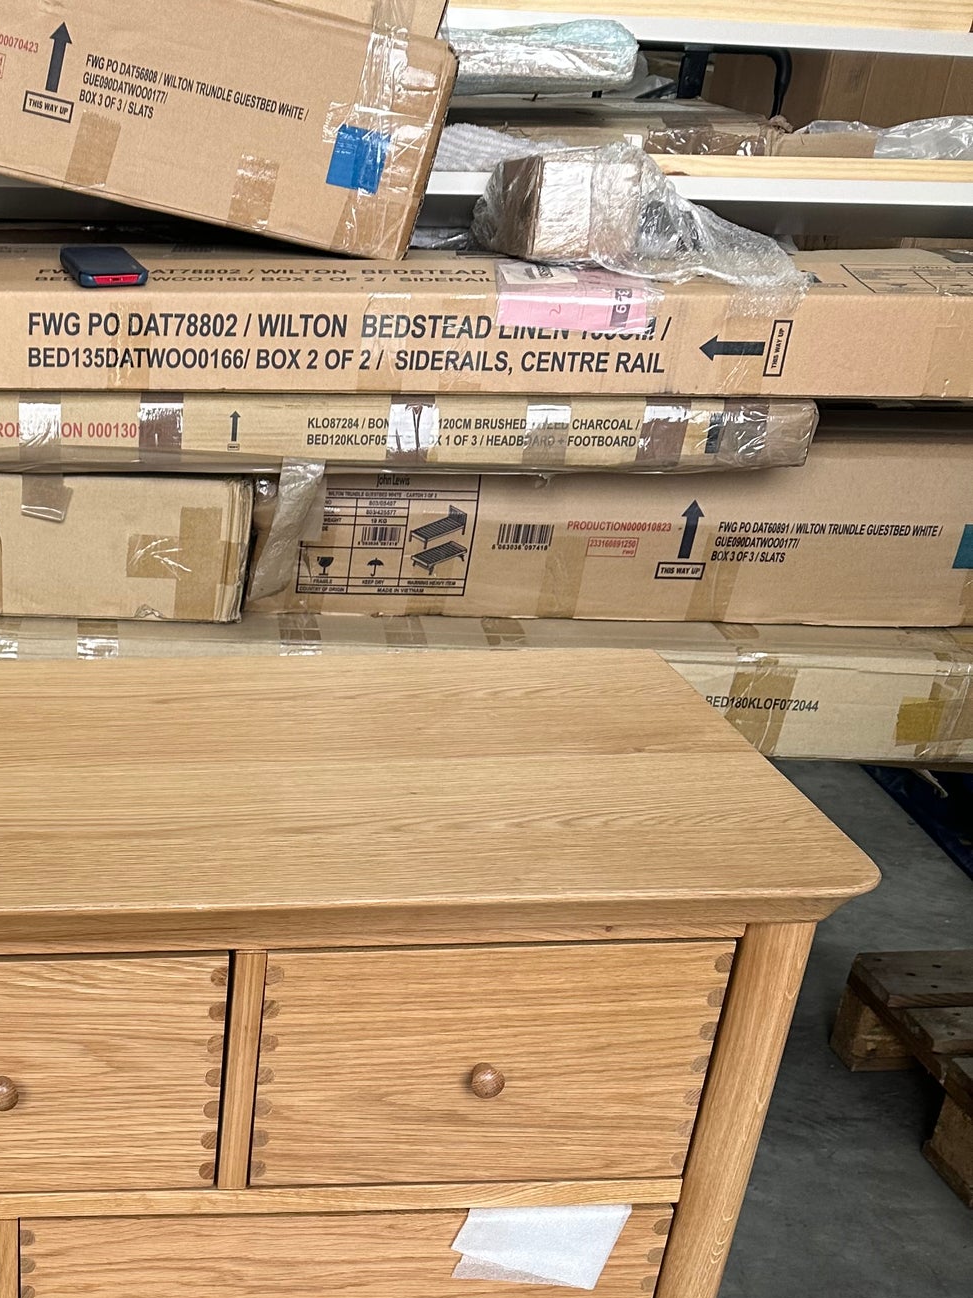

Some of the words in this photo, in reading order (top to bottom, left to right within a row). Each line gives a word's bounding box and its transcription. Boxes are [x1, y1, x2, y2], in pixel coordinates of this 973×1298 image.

[86, 54, 105, 70] FWG
[106, 58, 118, 73] PO
[119, 61, 158, 84] DAT56808
[163, 73, 194, 92] WILTON
[195, 81, 232, 102] TRUNDLE
[233, 91, 277, 113] GUESTBED
[277, 102, 304, 121] WHITE
[28, 98, 43, 109] THIS
[44, 102, 58, 113] WAY
[59, 105, 69, 115] UP
[79, 89, 97, 104] BOX
[97, 93, 104, 106] 3
[104, 95, 116, 108] OF
[116, 98, 123, 110] 3
[128, 101, 154, 119] SLATS
[361, 268, 487, 276] BEDSTEAD
[28, 312, 80, 337] FWG
[88, 312, 119, 337] PO
[128, 312, 237, 338] DAT78802
[243, 313, 252, 337] /
[258, 313, 347, 338] WILTON
[361, 314, 492, 339] BEDSTEAD
[660, 316, 672, 341] /
[774, 338, 782, 354] WAY
[779, 327, 785, 337] UP
[256, 349, 302, 370] BOX
[307, 349, 319, 370] 2
[324, 350, 353, 370] OF
[359, 350, 371, 371] 2
[376, 350, 384, 371] /
[395, 350, 513, 376] SIDERAILS,
[521, 352, 609, 373] CENTRE
[615, 353, 665, 374] RAIL
[438, 419, 471, 430] 120CM
[475, 419, 527, 430] BRUSHED
[572, 419, 633, 431] CHARCOAL
[445, 435, 450, 447] 1
[454, 435, 468, 446] OF
[471, 435, 477, 447] 3
[567, 435, 637, 447] FOOTBOARD
[377, 474, 392, 487] John
[392, 475, 410, 486] Lewis
[567, 521, 671, 532] PRODUCTION000010823
[718, 521, 738, 533] FWG
[738, 522, 751, 533] PO
[752, 522, 790, 534] DAT60891
[795, 523, 826, 535] WILTON
[828, 523, 865, 536] TRUNDLE
[866, 524, 911, 536] GUESTBED
[912, 525, 937, 537] WHITE
[711, 551, 729, 562] BOX
[729, 552, 736, 562] 3
[736, 552, 749, 562] OF
[749, 552, 755, 562] 3
[760, 552, 785, 563] SLATS
[660, 567, 675, 575] THIS
[676, 567, 690, 575] WAY
[691, 567, 701, 575] UP
